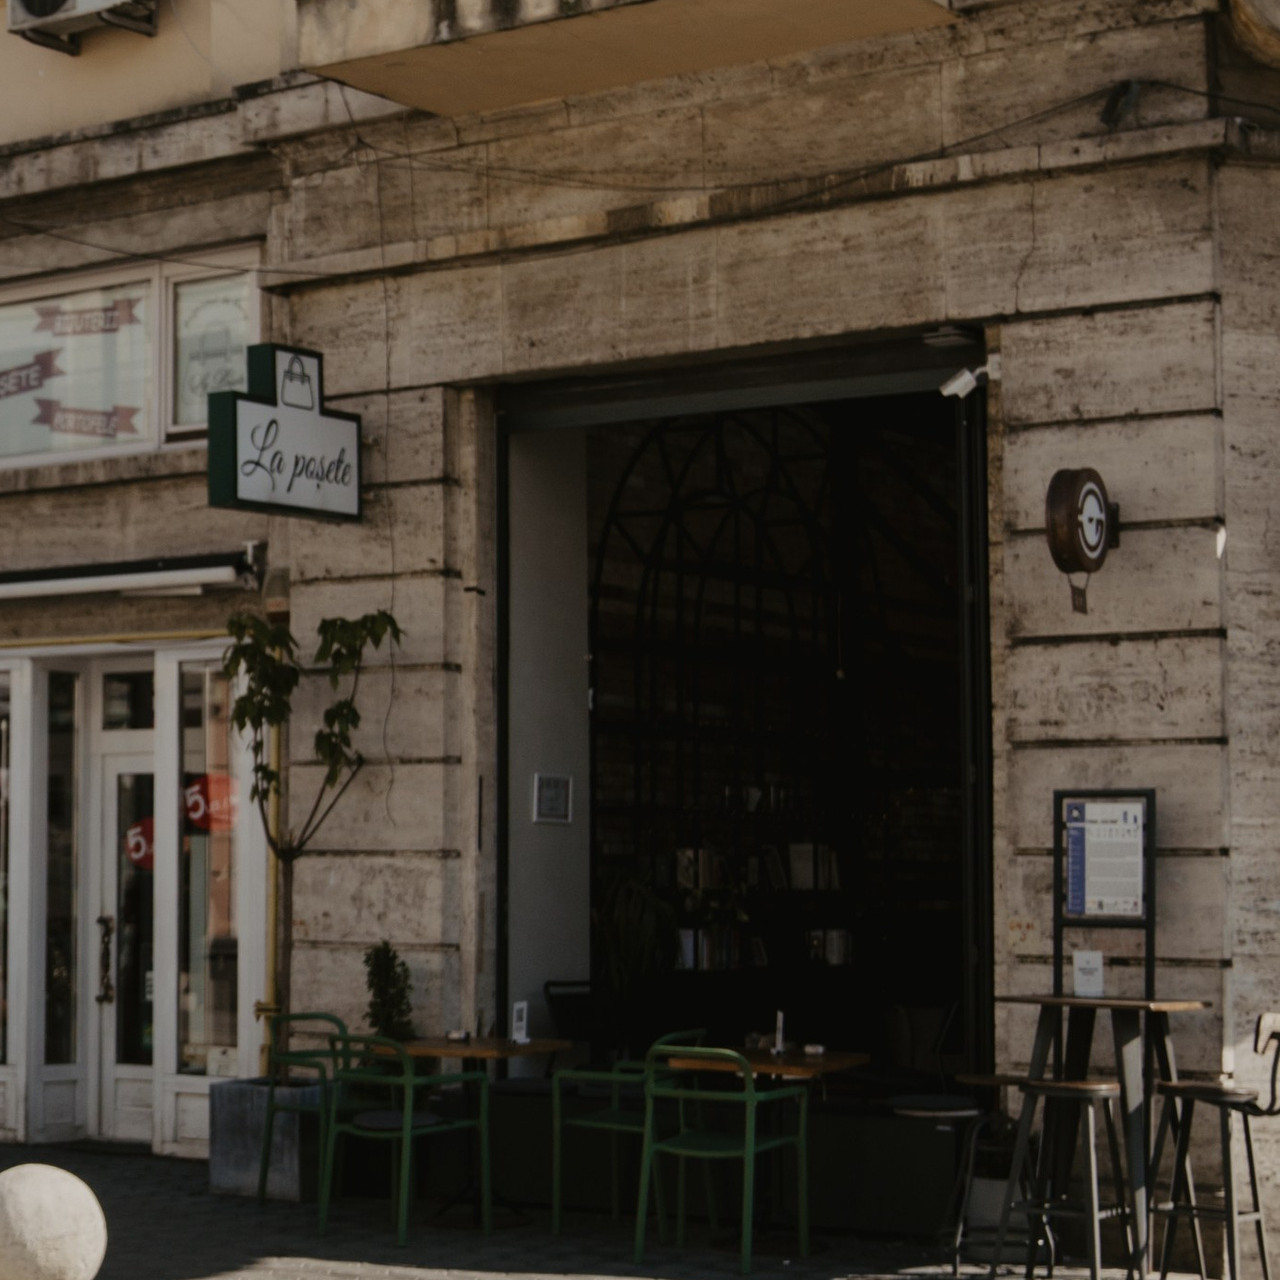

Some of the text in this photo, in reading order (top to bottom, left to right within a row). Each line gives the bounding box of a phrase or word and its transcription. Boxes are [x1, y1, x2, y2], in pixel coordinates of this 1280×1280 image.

[241, 419, 351, 493] La poșete
[184, 784, 205, 819] 5
[126, 826, 147, 860] 5
